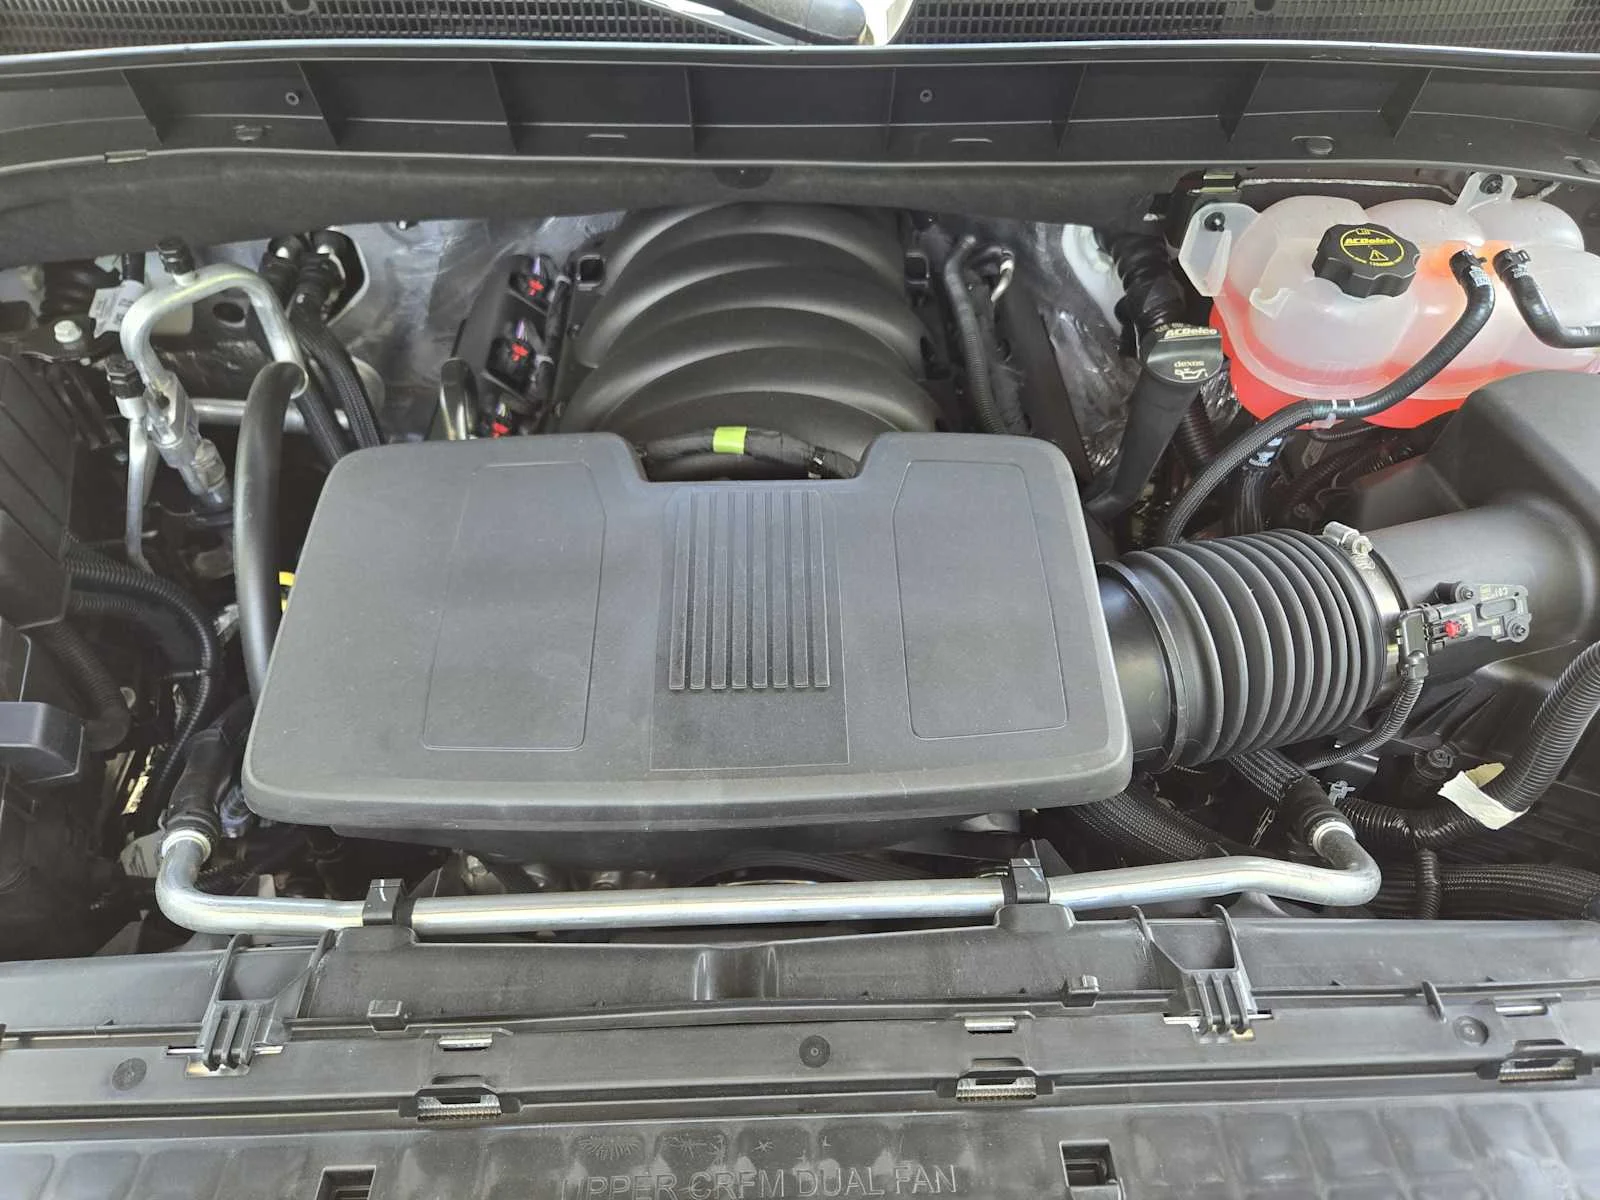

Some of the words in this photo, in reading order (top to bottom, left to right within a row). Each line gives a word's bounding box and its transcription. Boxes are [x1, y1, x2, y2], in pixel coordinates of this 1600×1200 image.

[1343, 237, 1396, 246] ACDelco
[1164, 326, 1218, 339] ACDelco
[560, 1173, 678, 1200] UPPER
[796, 1166, 885, 1197] DUAL
[895, 1161, 958, 1195] FAN
